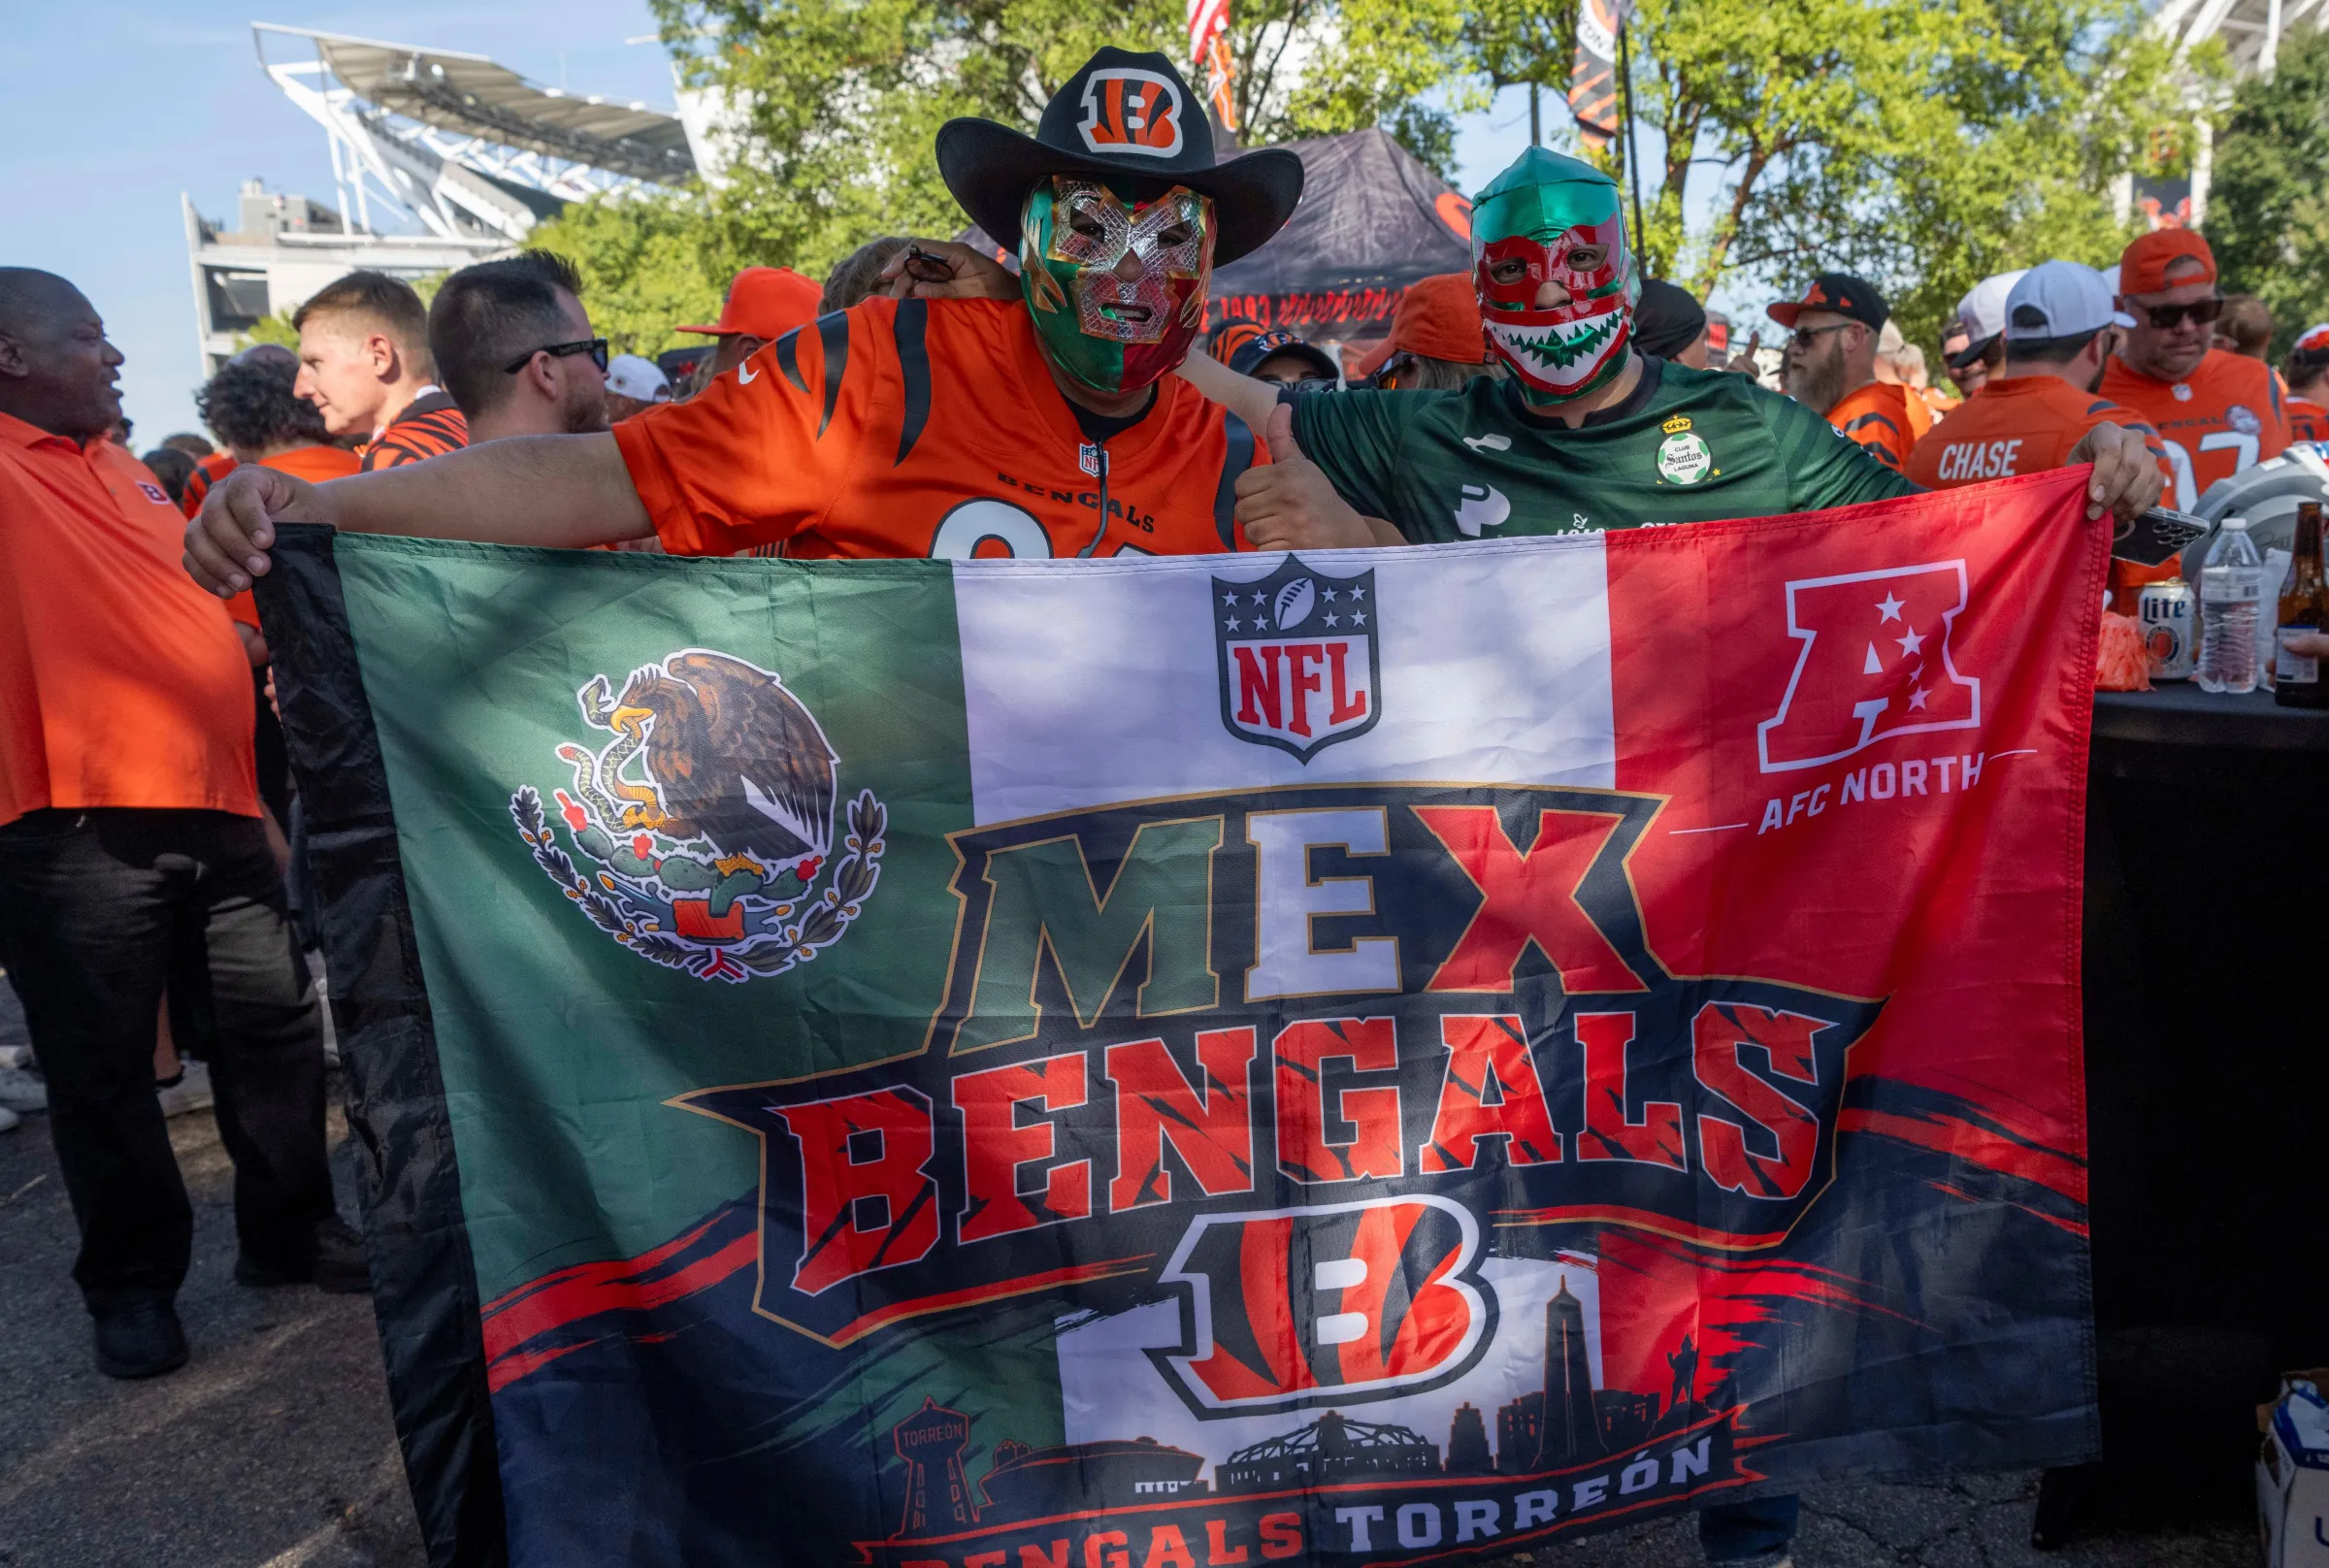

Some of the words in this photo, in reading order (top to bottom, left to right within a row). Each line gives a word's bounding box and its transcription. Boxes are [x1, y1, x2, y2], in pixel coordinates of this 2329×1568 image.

[1084, 456, 1099, 472] NF
[1665, 451, 1703, 469] Santos
[1674, 463, 1699, 473] LAGUNA
[1938, 439, 2023, 480] CHASE
[997, 472, 1155, 534] BENGALS
[2143, 597, 2186, 624] Lite
[1233, 642, 1366, 737] NFL
[1757, 783, 1831, 834] AFC
[1840, 752, 1985, 805] NORTH
[949, 805, 1650, 1057] MEX
[762, 1000, 1837, 1297] BENGALS
[902, 1421, 964, 1448] TORREÓN
[1335, 1436, 1712, 1552] TORREÓN
